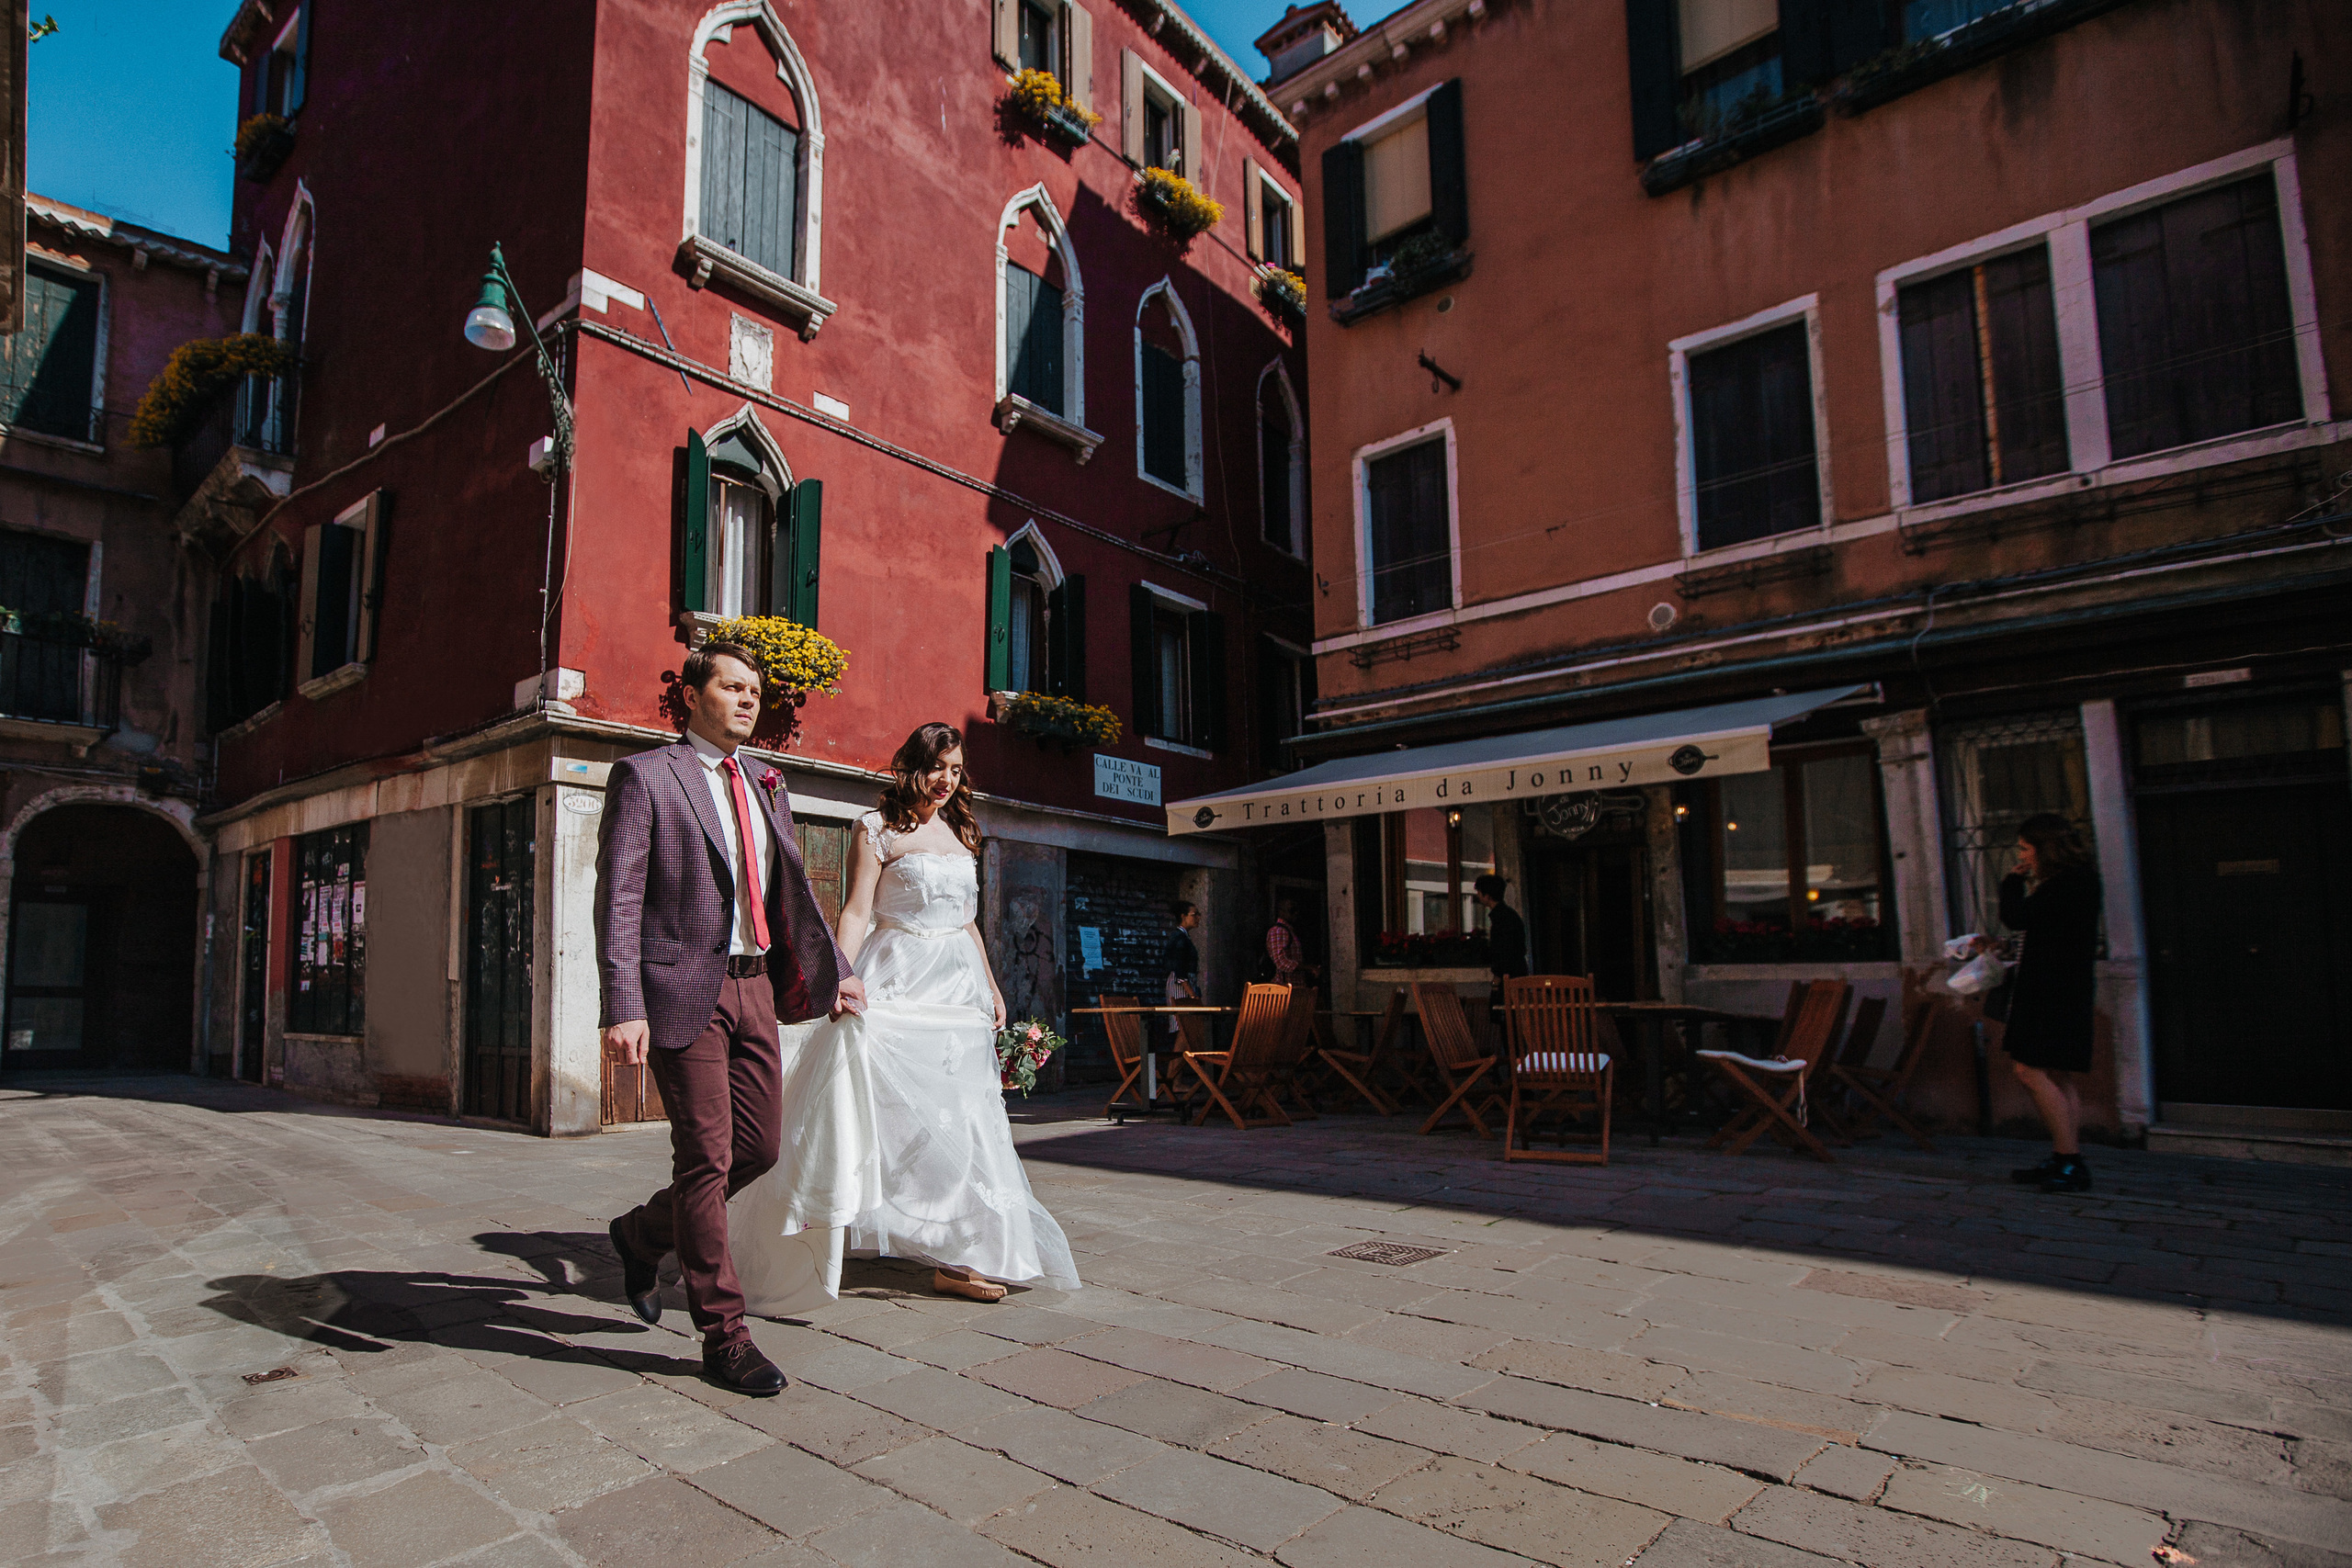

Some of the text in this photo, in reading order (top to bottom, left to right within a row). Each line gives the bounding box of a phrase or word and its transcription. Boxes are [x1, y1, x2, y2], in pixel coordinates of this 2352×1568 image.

[1095, 756, 1159, 779] CALLE VA AL
[1113, 772, 1144, 787] PONTE
[1242, 760, 1634, 820] Trattoria da Jonny
[1102, 782, 1154, 801] DEI SCUDI
[1547, 799, 1589, 825] Jonny
